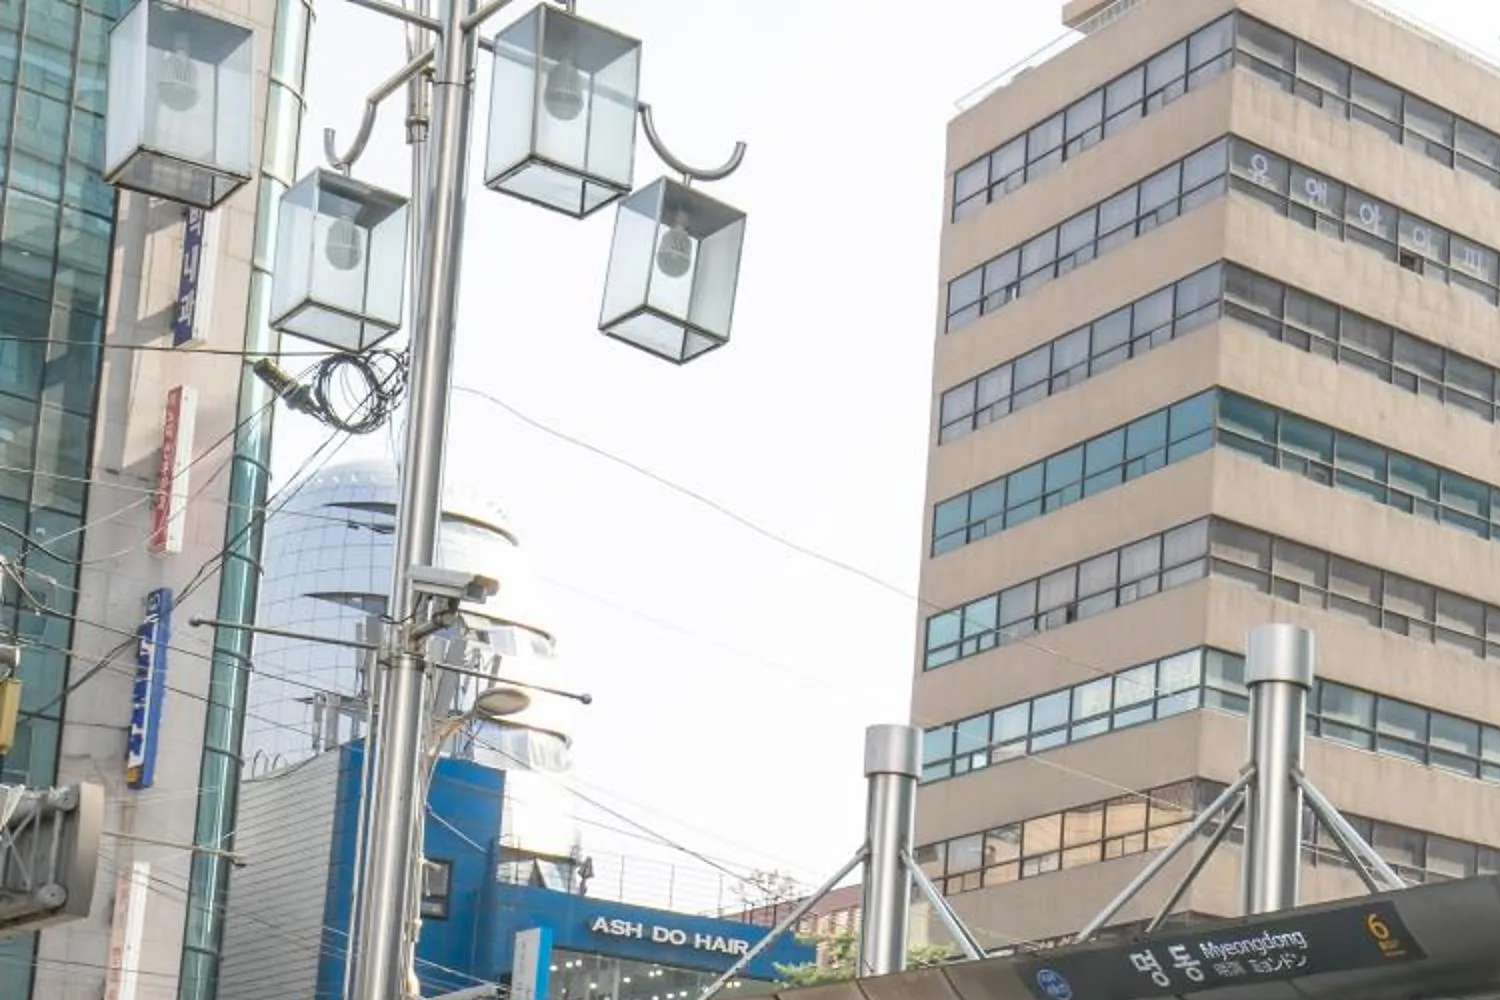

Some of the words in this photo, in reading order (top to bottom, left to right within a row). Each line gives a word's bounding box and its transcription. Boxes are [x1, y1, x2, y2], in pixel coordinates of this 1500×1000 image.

[591, 915, 642, 939] ASH
[652, 925, 687, 945] DO
[694, 934, 749, 955] HAIR
[1368, 913, 1389, 940] 6
[1129, 944, 1205, 987] 명동
[1200, 930, 1308, 960] Myeongdong
